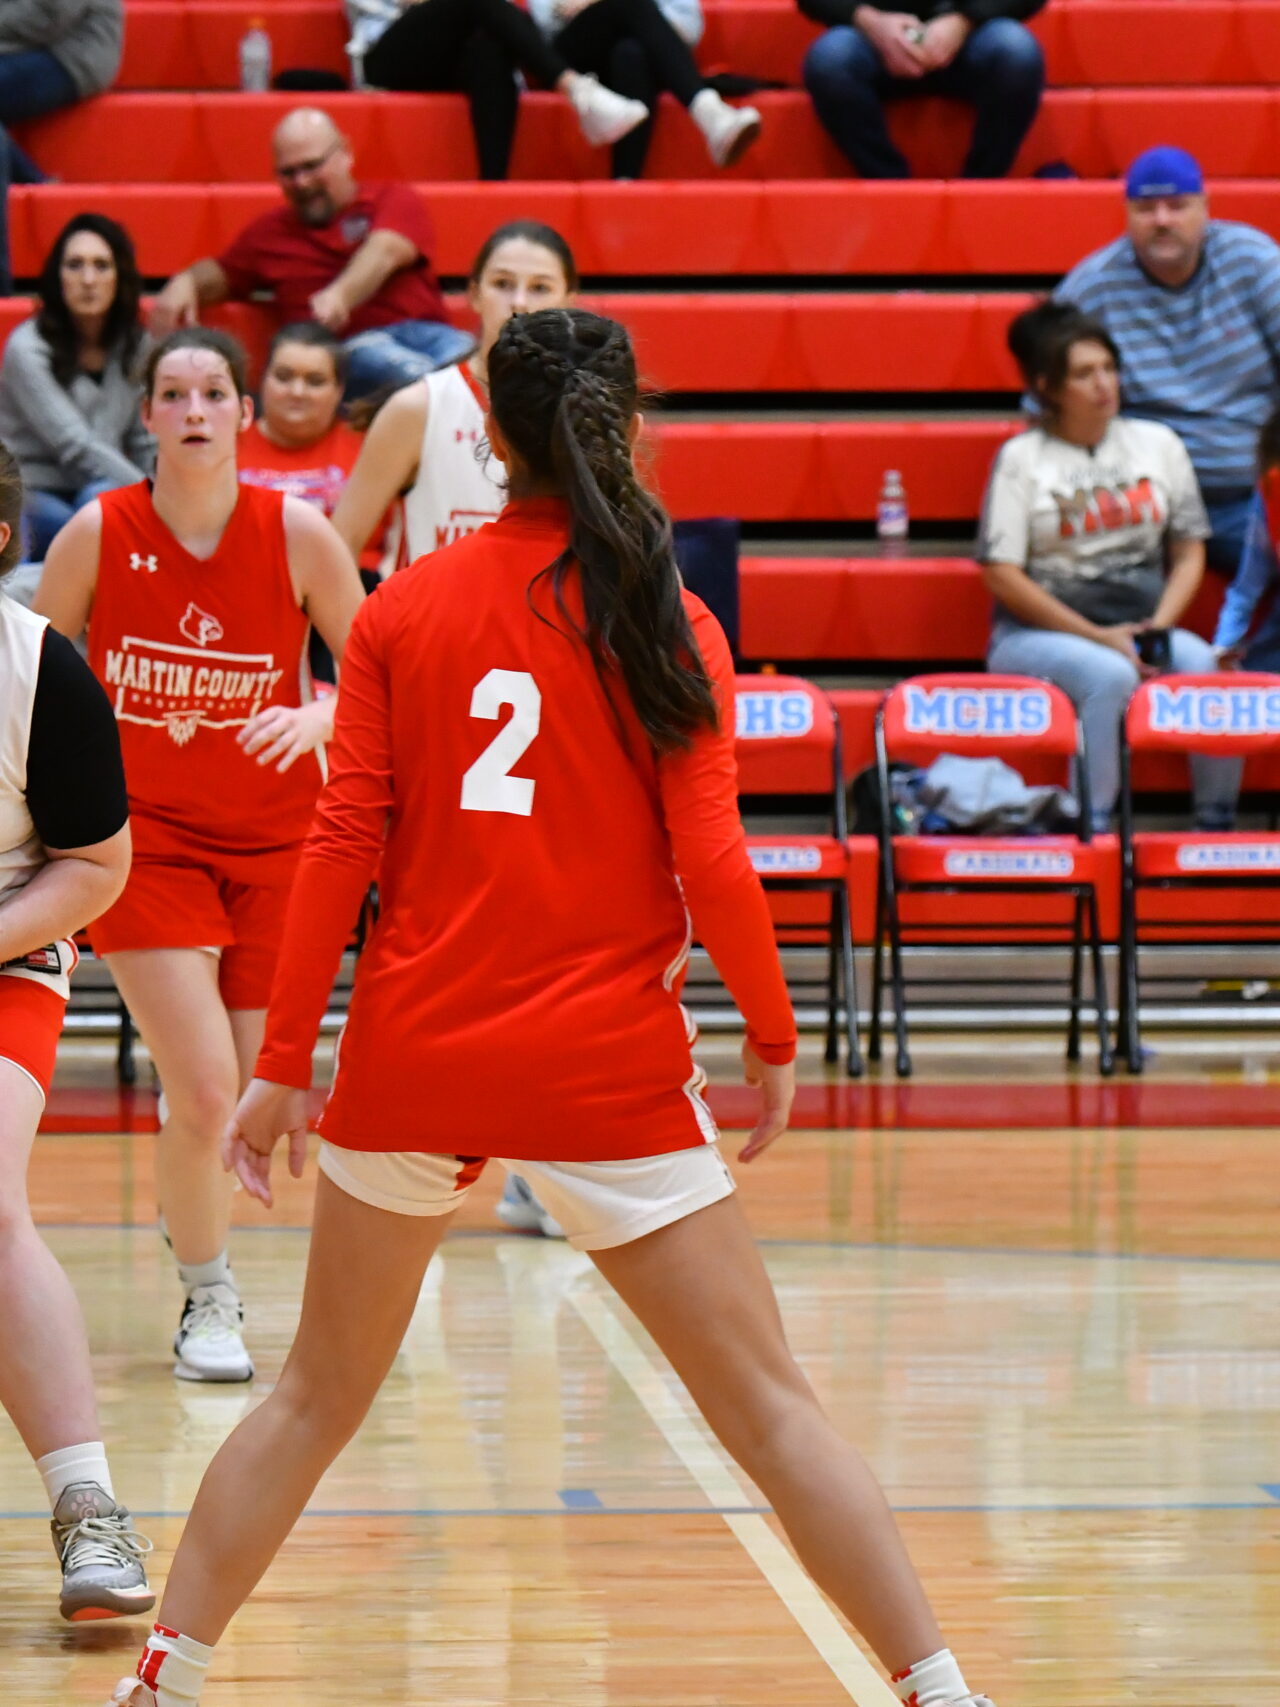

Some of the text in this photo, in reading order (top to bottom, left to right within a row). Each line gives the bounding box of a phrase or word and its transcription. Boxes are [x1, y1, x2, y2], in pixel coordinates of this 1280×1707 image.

[105, 649, 284, 700] MARTIN COUNTY
[744, 697, 807, 733] HS
[907, 691, 1051, 733] MCHS
[459, 668, 542, 816] 2
